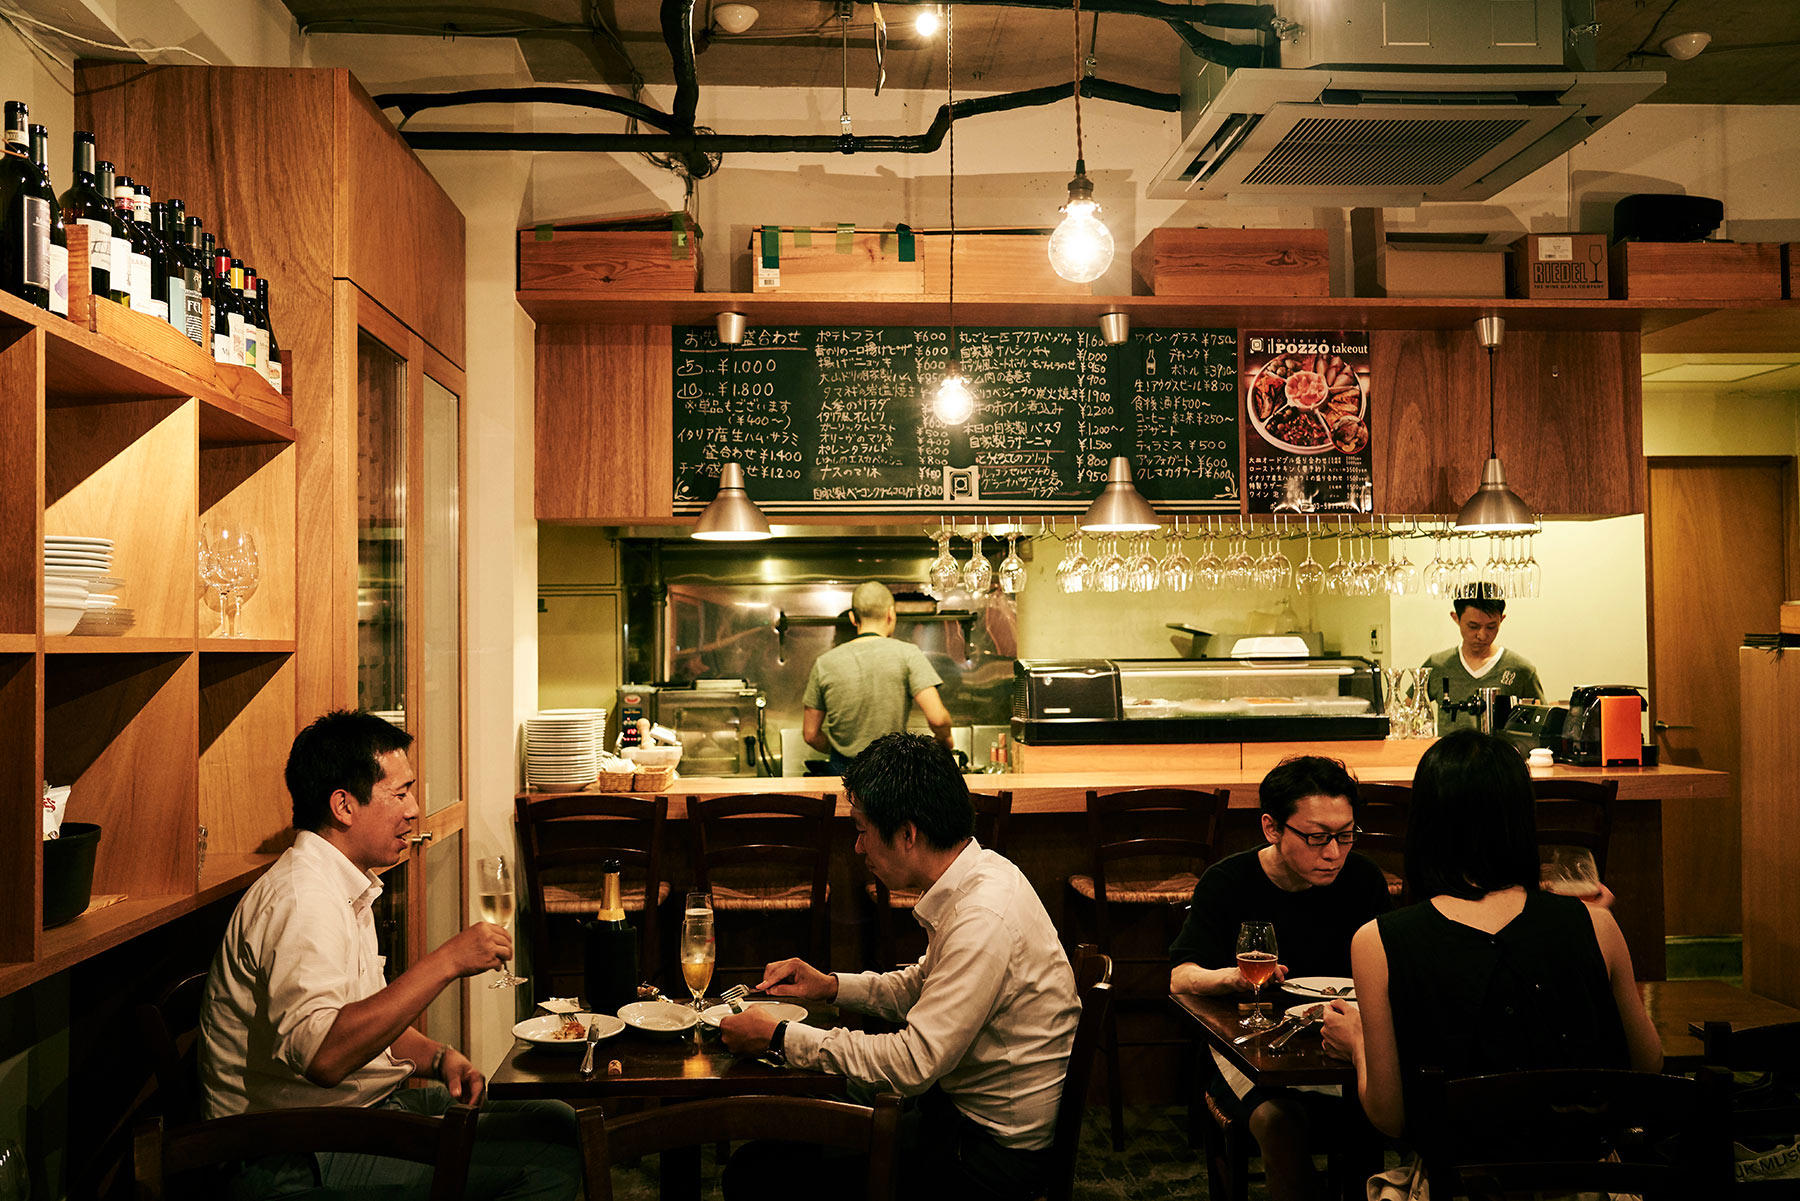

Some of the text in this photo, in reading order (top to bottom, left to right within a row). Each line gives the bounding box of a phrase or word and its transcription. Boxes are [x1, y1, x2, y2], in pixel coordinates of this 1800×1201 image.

[1534, 263, 1587, 284] RIEDEL
[816, 329, 947, 344] ポテトフライ ¥600
[914, 344, 949, 357] ¥600
[1267, 337, 1368, 354] il POZZO takeout
[914, 357, 946, 373] ¥600
[1136, 424, 1180, 438] デザート
[1135, 439, 1227, 452] ティラミス ¥500
[679, 462, 759, 479] チーズ盛せ
